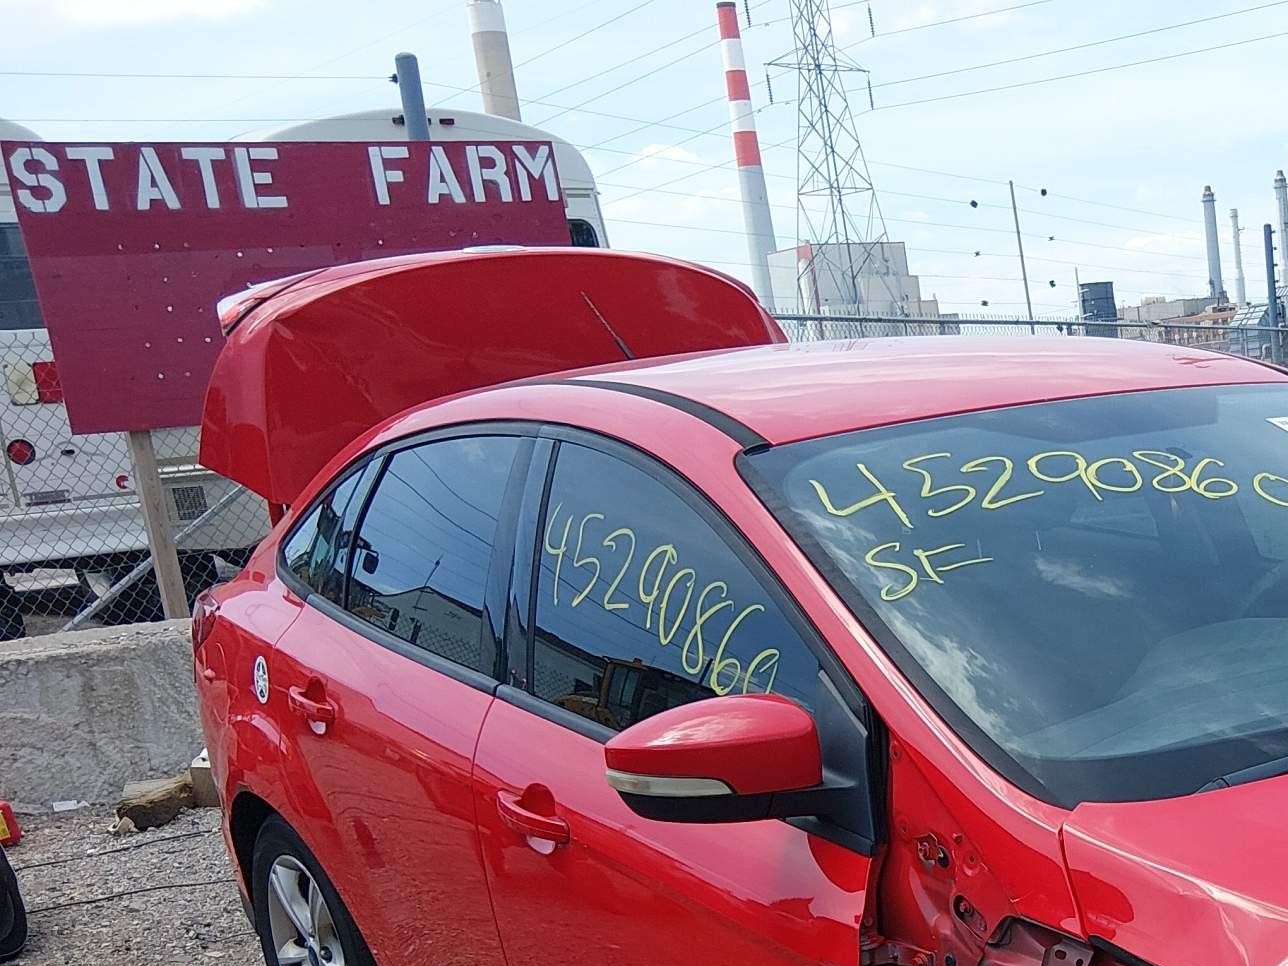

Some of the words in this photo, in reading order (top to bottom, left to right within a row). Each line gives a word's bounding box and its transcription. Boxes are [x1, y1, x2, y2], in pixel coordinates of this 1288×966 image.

[9, 145, 289, 214] STATE
[367, 144, 560, 206] FARM
[864, 541, 995, 602] SF
